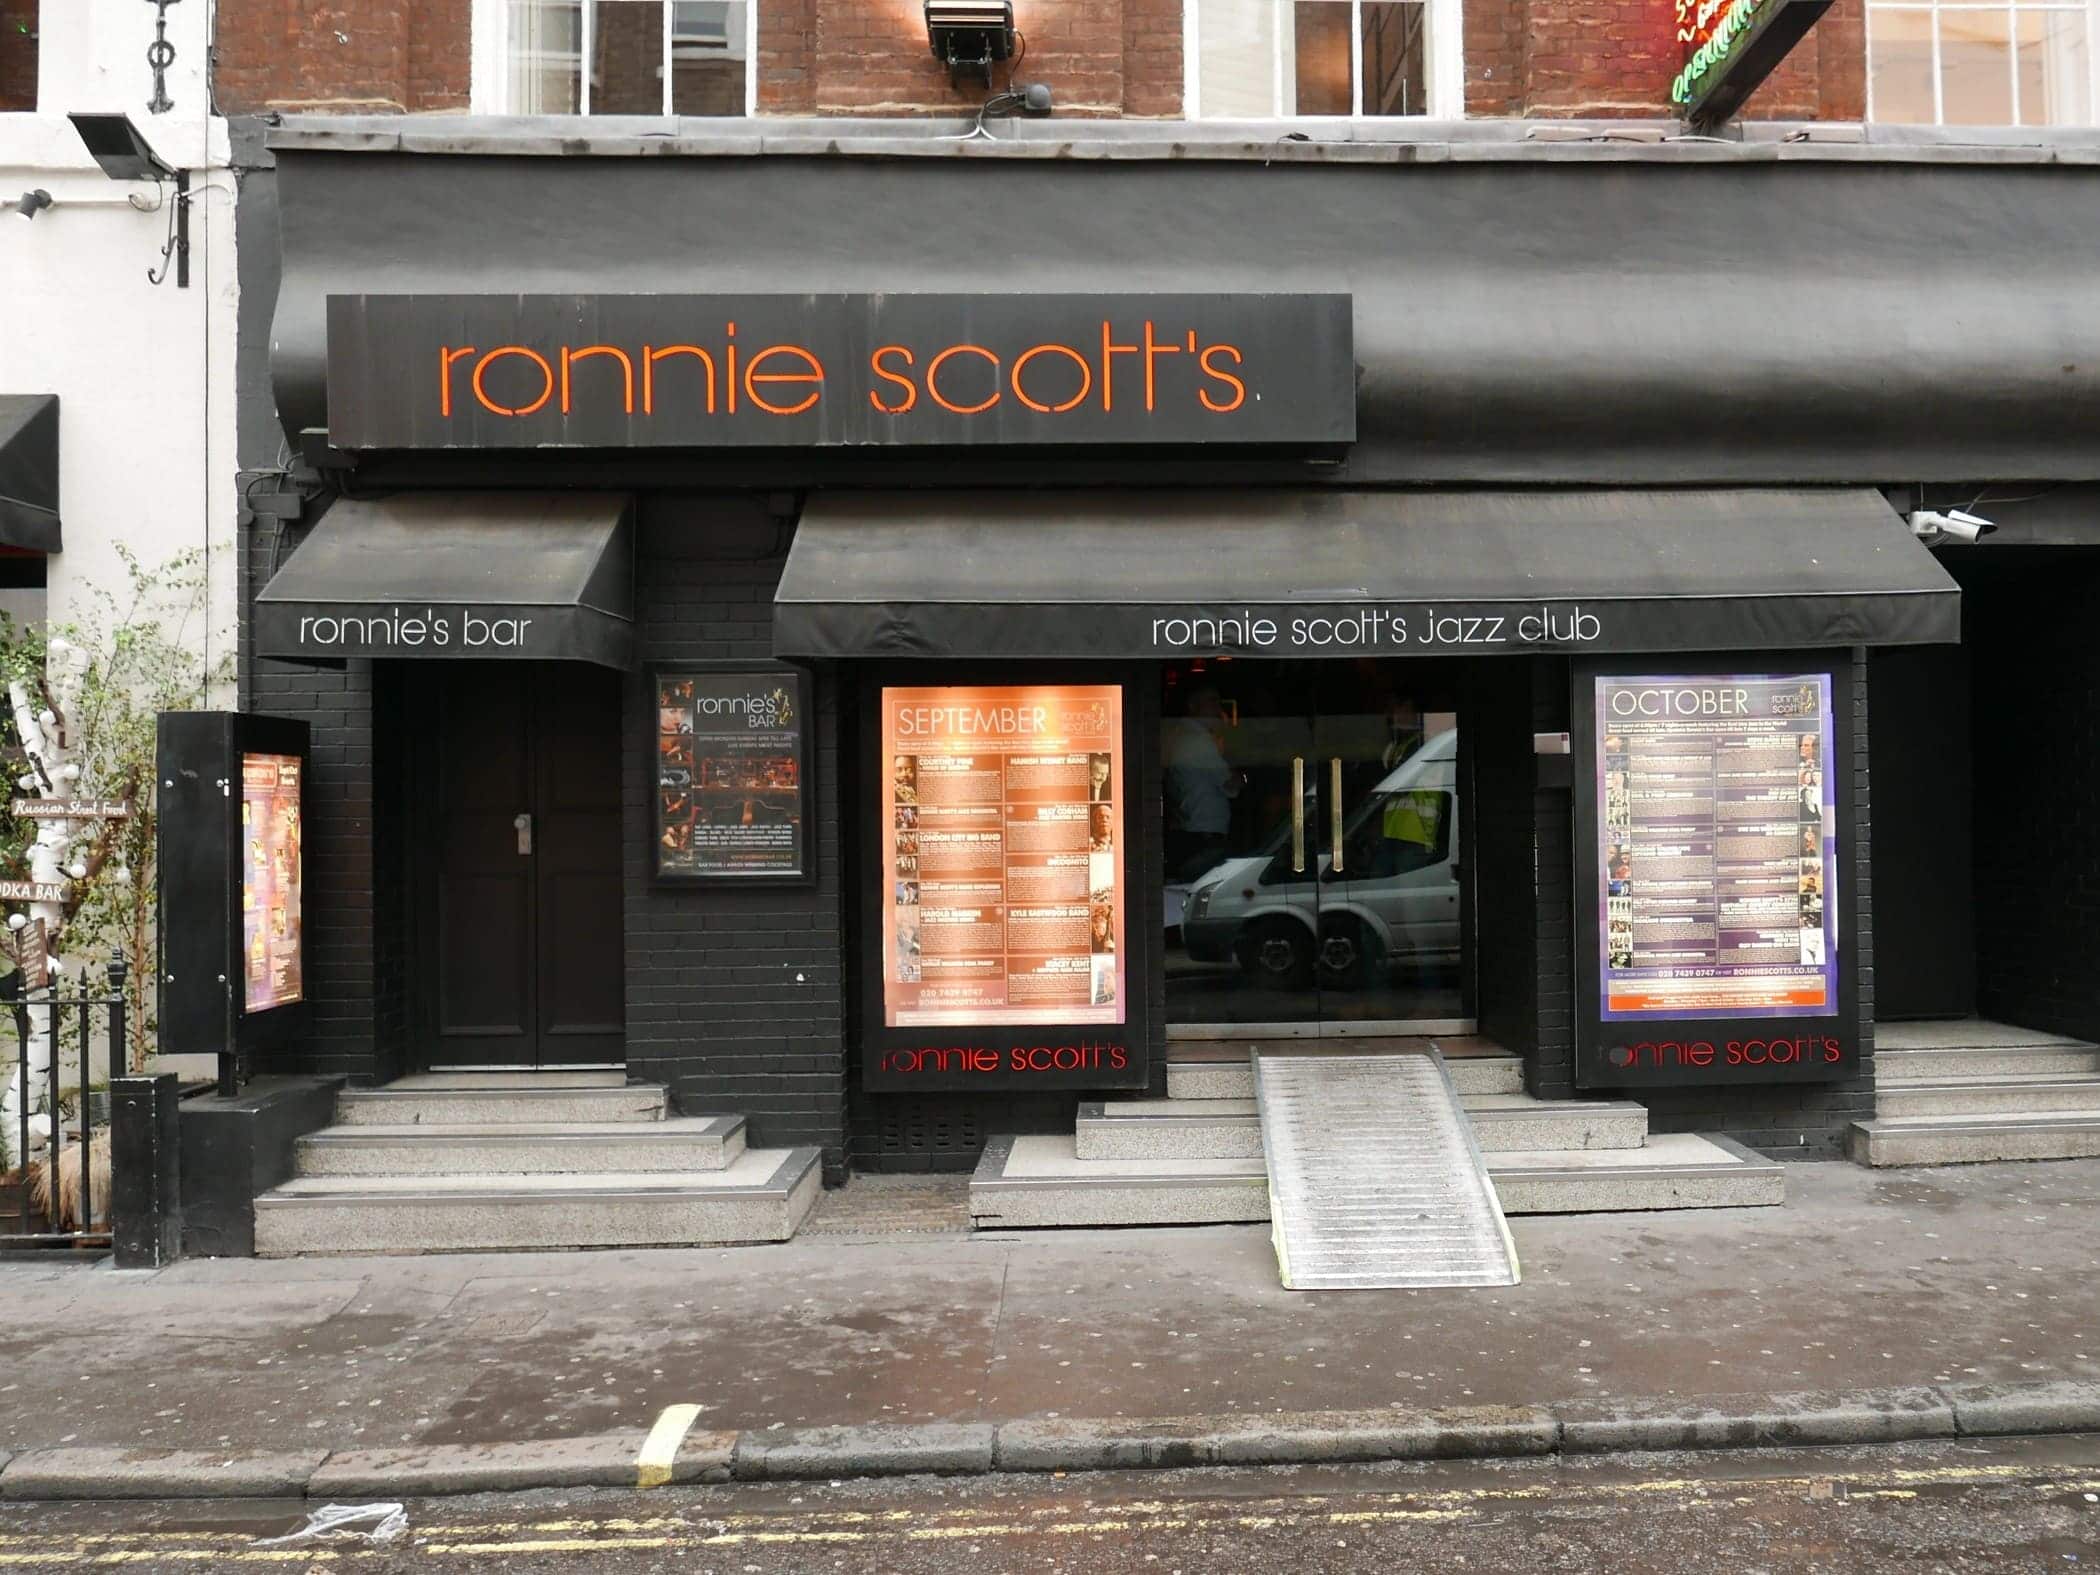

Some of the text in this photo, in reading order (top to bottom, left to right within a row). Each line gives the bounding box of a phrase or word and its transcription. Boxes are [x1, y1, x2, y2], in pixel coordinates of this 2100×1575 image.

[441, 320, 1245, 416] ronnie scott's
[300, 608, 533, 646] ronnie's bar
[1153, 606, 1601, 646] ronnie scott's jazz club
[697, 693, 776, 714] ronnie's
[1612, 689, 1750, 716] OCTOBER
[748, 714, 776, 728] BAR
[899, 706, 1047, 735] SEPTEMBER
[14, 801, 64, 815] Russian
[36, 884, 62, 900] BAR
[1011, 1040, 1127, 1071] scott's
[1726, 1035, 1841, 1065] scott's
